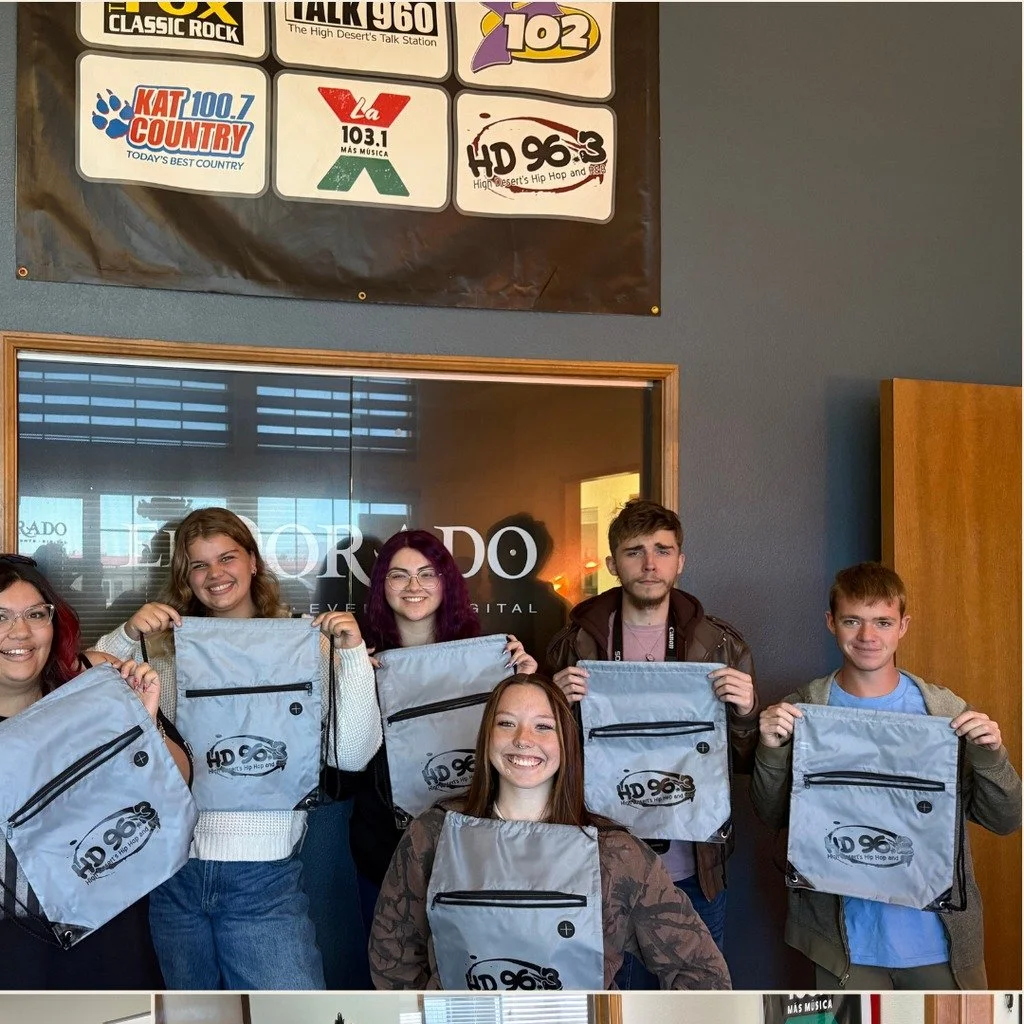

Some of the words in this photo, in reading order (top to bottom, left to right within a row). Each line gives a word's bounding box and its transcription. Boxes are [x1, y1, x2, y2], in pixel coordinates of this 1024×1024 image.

[109, 14, 185, 36] CLASSIC
[189, 19, 240, 43] ROCK
[372, 2, 434, 34] 960
[288, 23, 308, 35] The
[310, 26, 334, 39] High
[336, 29, 377, 42] Desert's
[380, 33, 400, 45] Talk
[402, 36, 437, 47] Station
[134, 88, 185, 118] KAT
[191, 91, 255, 120] 100.7
[350, 97, 380, 121] La
[129, 117, 248, 152] COUNTRY
[342, 125, 388, 148] 103.1
[127, 150, 168, 165] TODAY'S
[170, 157, 193, 167] BEST
[196, 159, 244, 170] COUNTRY
[341, 146, 357, 154] MÁS
[359, 148, 389, 158] MÚSICA
[466, 142, 517, 178] HD
[521, 130, 608, 172] 96.3
[473, 179, 493, 191] High
[531, 174, 546, 184] Hip
[548, 170, 567, 181] Hop
[570, 167, 586, 177] and
[206, 748, 236, 768] HD
[238, 741, 288, 765] 96.3
[421, 764, 451, 786] HD
[616, 782, 646, 801] HD
[647, 774, 696, 797] 96.3
[71, 845, 107, 880] HD
[103, 800, 157, 851] 96.3
